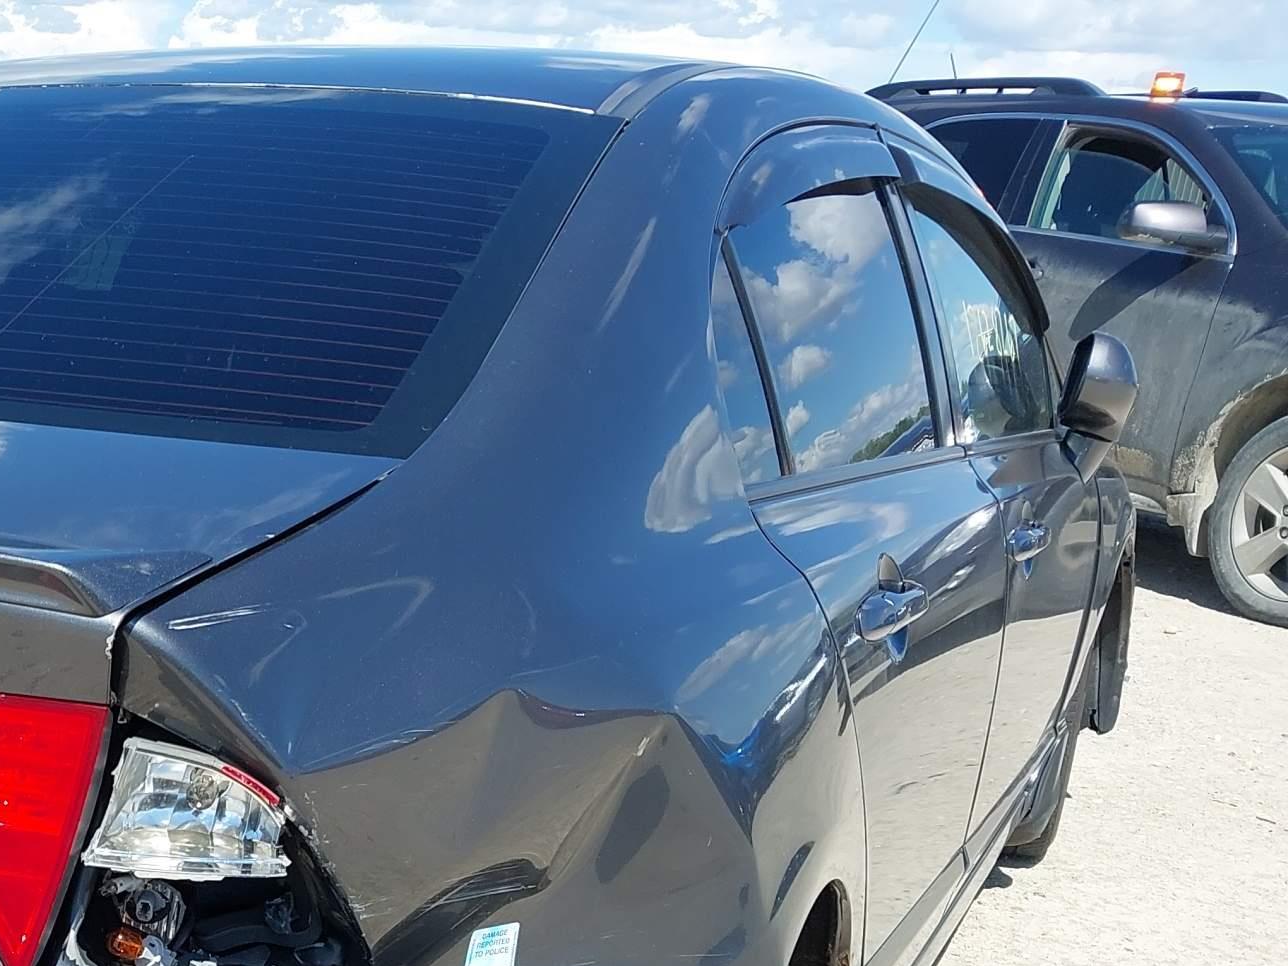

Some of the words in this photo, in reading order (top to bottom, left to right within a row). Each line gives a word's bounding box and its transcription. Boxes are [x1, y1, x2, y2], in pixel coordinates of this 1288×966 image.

[481, 928, 509, 940] DAMAGE
[476, 937, 510, 949] REPORTED
[485, 946, 509, 957] POLICE
